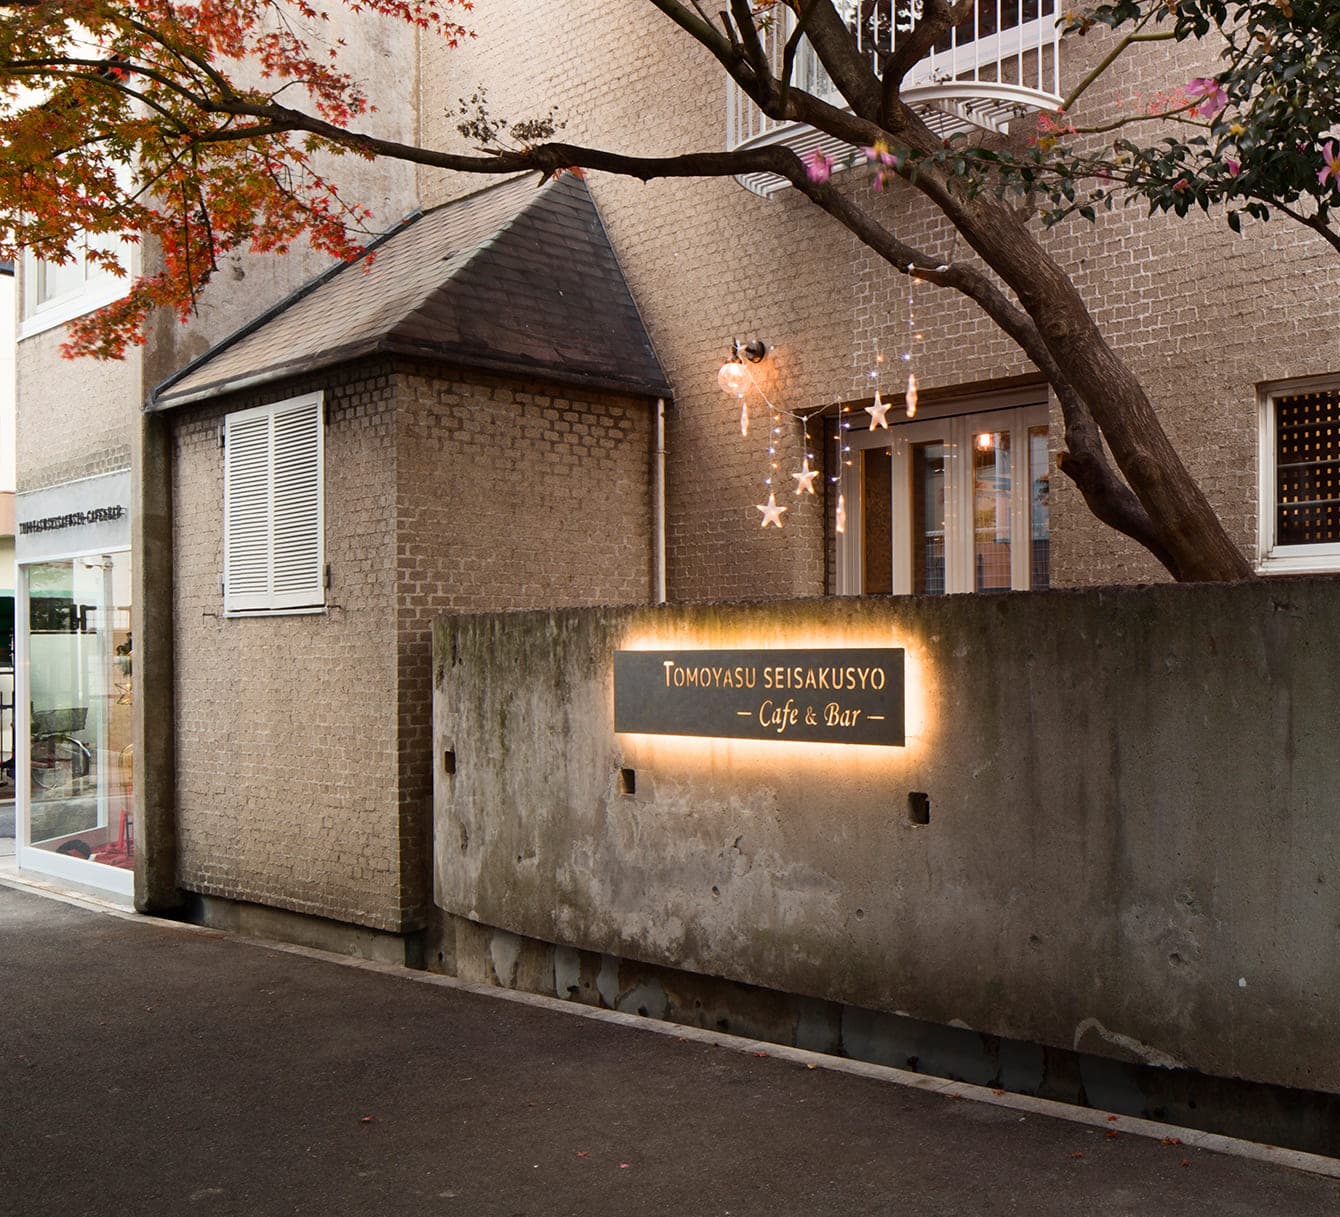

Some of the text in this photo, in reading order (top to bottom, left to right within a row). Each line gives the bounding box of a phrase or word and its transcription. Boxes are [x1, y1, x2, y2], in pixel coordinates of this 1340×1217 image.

[663, 660, 886, 691] TOMOYASU SEISAKUSYO
[758, 698, 862, 733] Cafe & Bar
